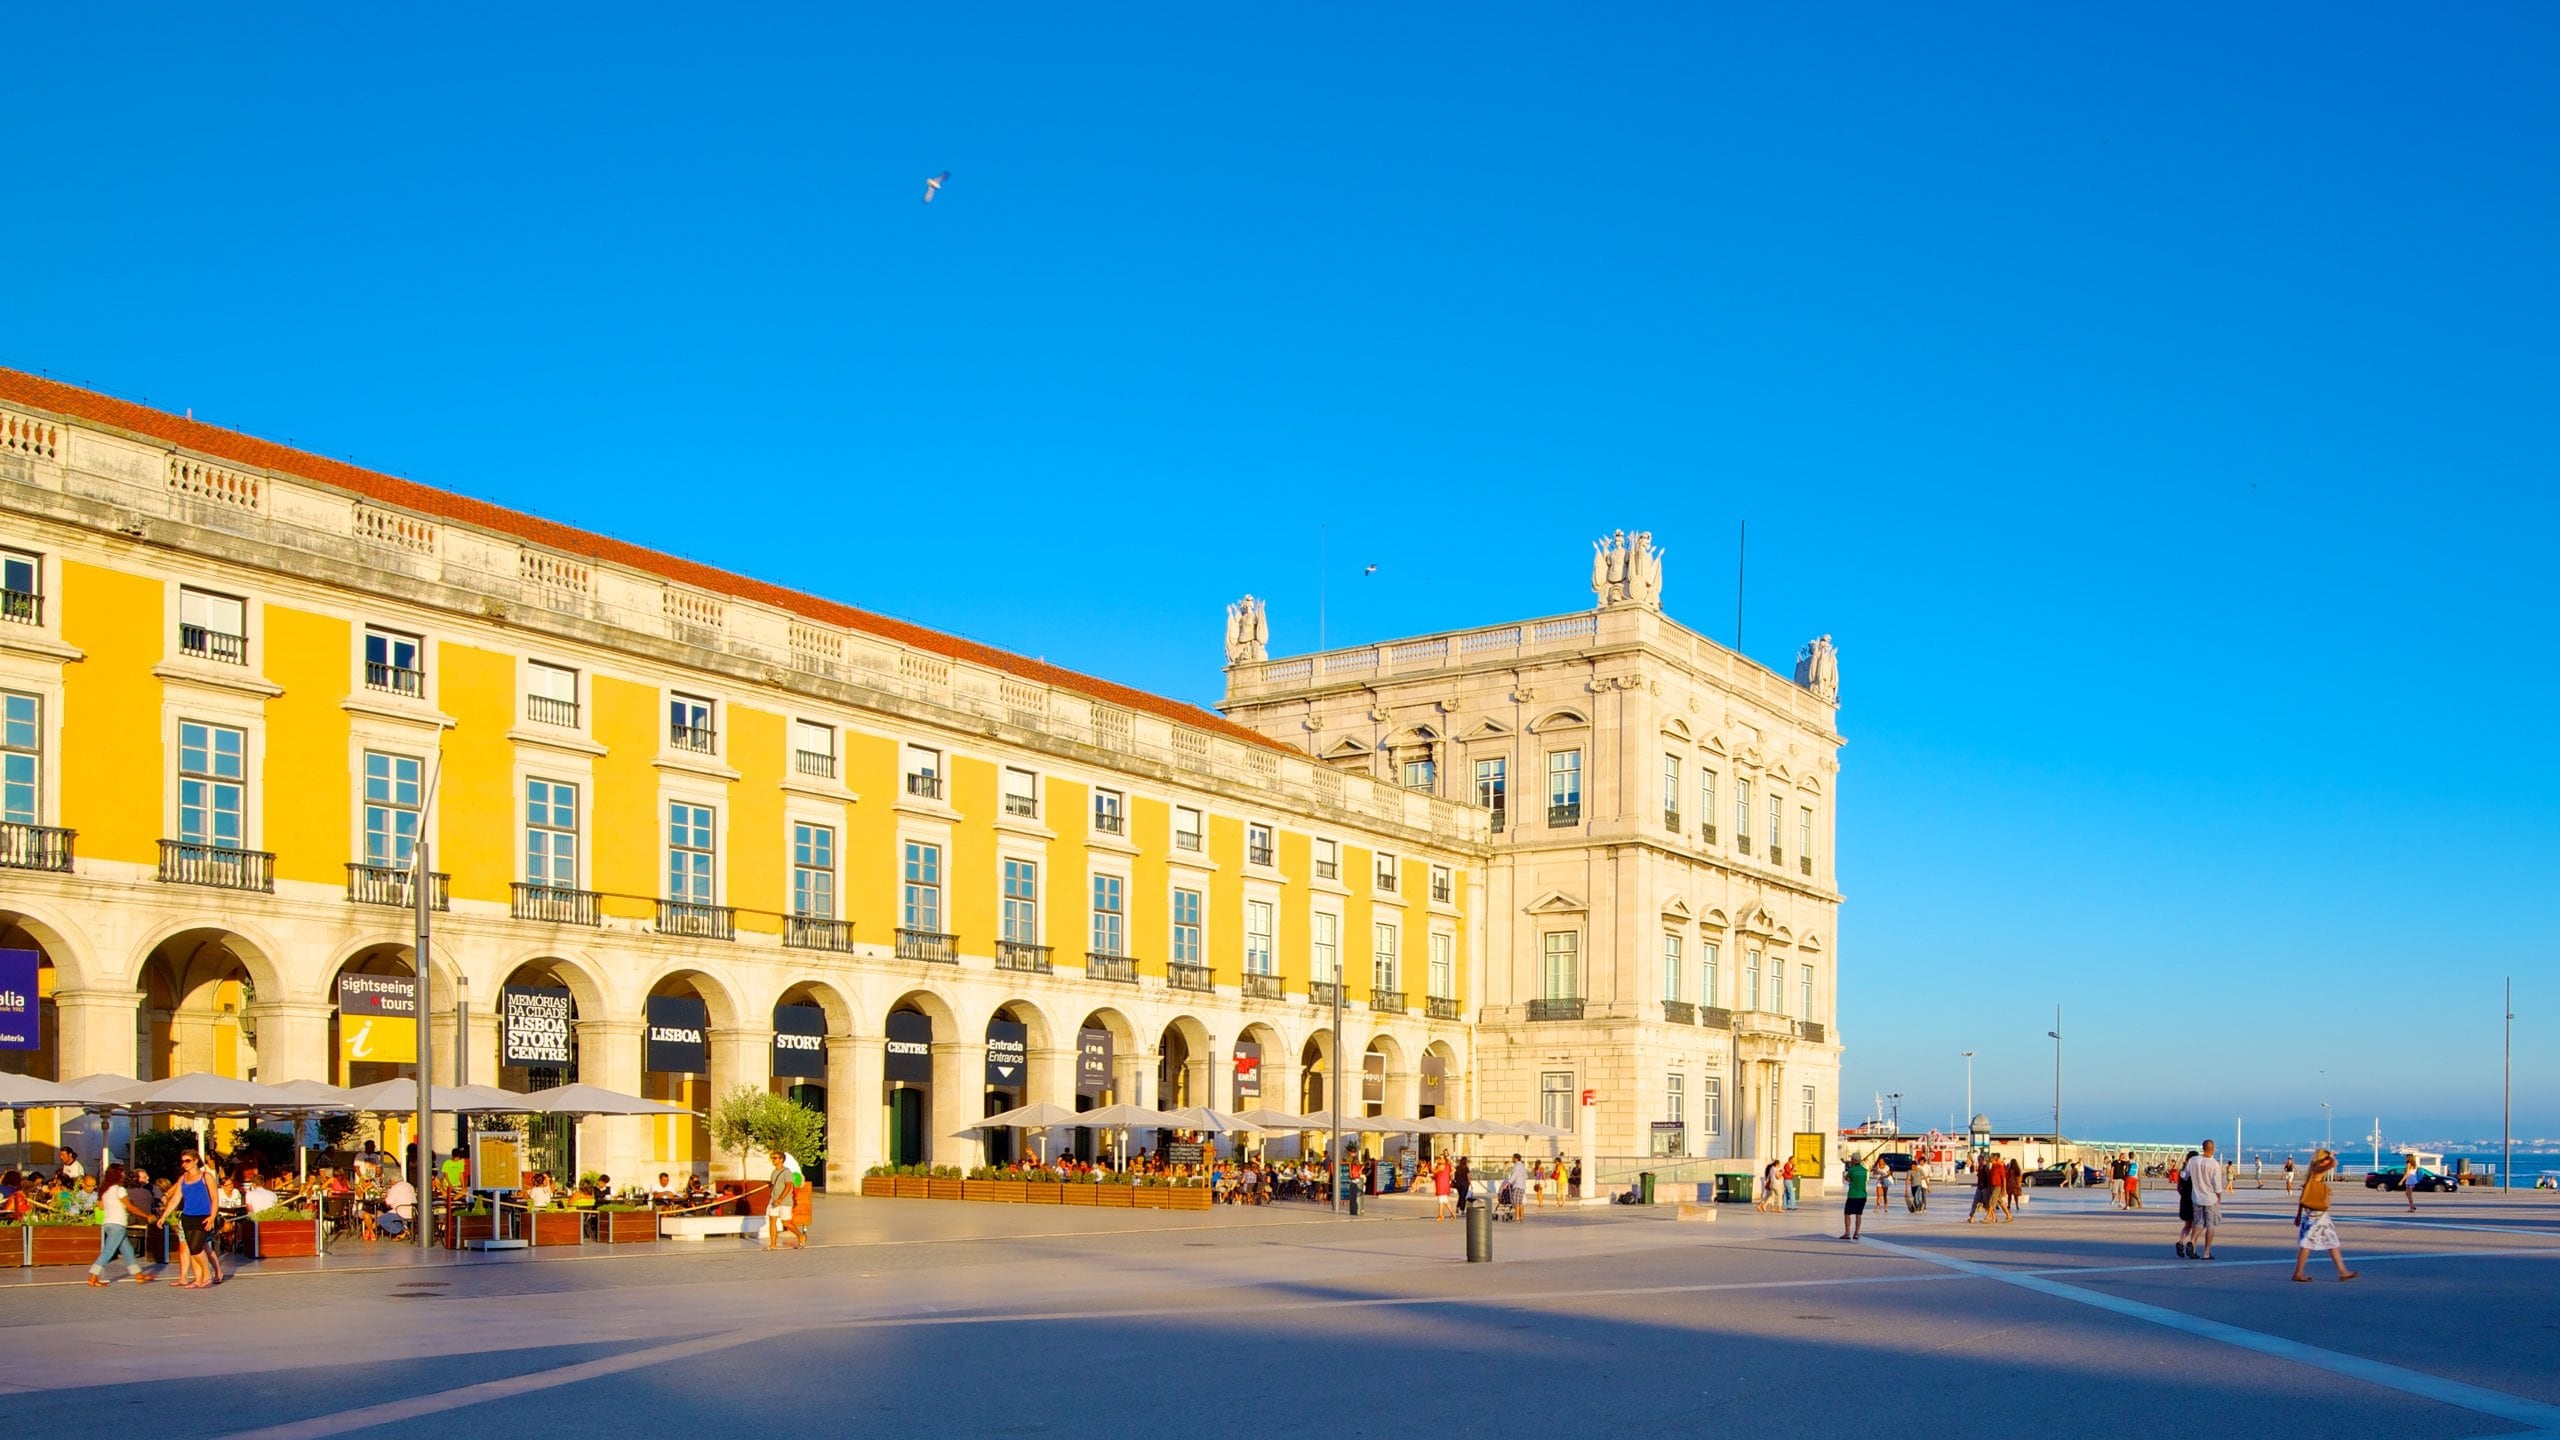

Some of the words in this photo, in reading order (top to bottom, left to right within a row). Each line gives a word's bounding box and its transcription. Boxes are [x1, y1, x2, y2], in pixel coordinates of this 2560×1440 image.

[342, 977, 414, 997] sightseeing
[380, 997, 415, 1011] tours
[508, 993, 567, 1009] MEMÓRIAS
[508, 1005, 525, 1016] DA
[526, 1006, 567, 1019] CIDADE
[508, 1016, 567, 1033] LISBOA
[508, 1030, 568, 1049] STORY
[651, 1027, 701, 1043] LISBOA
[777, 1034, 822, 1050] STORY
[887, 1042, 928, 1055] CENTRE
[989, 1039, 1023, 1052] Entrada
[508, 1046, 567, 1062] CENTRE
[988, 1051, 1024, 1064] Entrance
